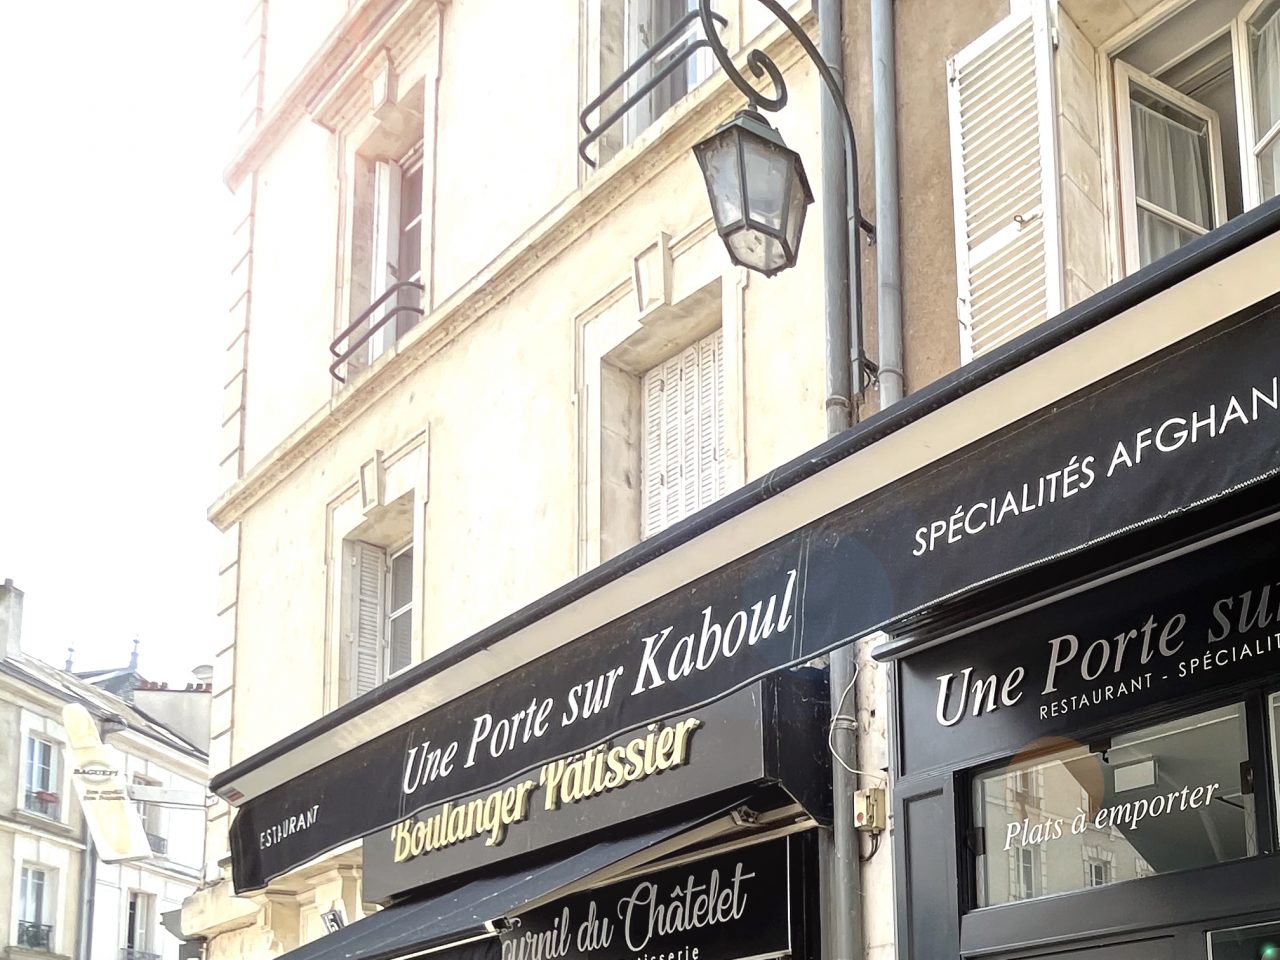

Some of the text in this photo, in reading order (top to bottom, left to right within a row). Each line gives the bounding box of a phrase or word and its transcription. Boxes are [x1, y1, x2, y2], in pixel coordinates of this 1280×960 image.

[912, 455, 1095, 556] SPÉCIALITÉS
[403, 569, 797, 794] Une Porte sur Kaboul
[935, 665, 1025, 727] Une
[1041, 612, 1186, 696] Porte
[1039, 673, 1152, 720] RESTAURANT
[259, 805, 320, 850] ESTAURANT
[391, 780, 534, 863] Boulanger
[1003, 779, 1220, 852] Plats à emporter
[577, 900, 614, 952] du
[617, 863, 755, 952] Châtelet
